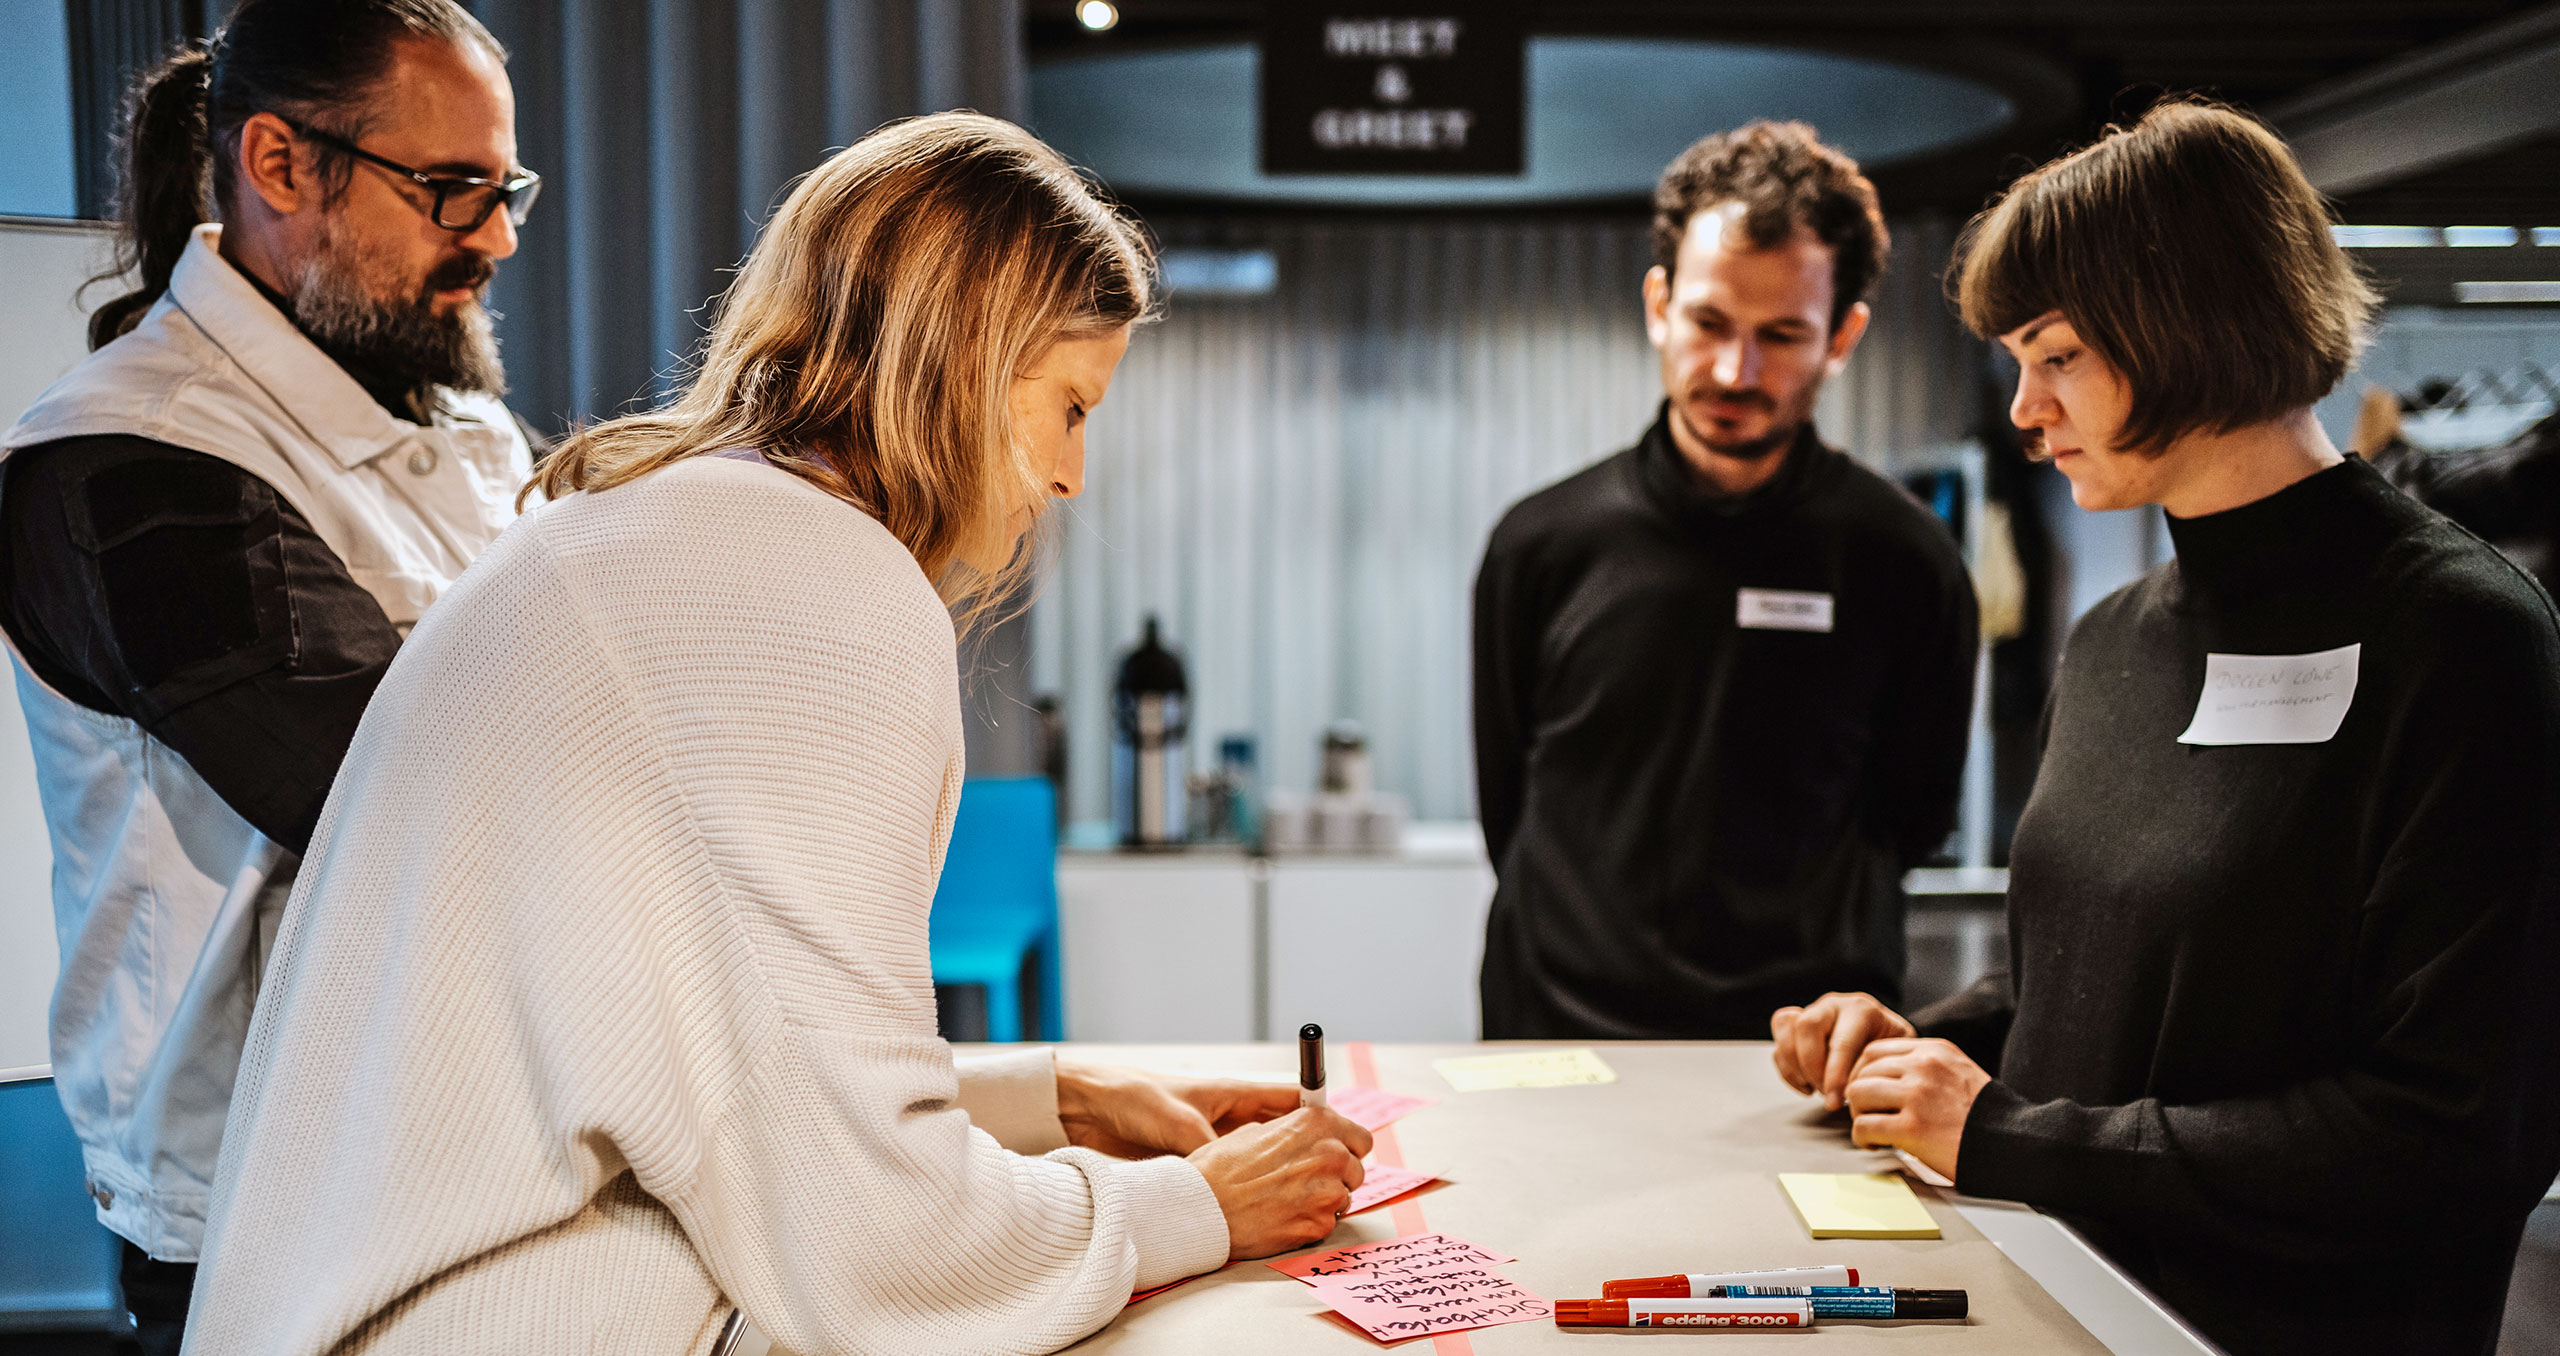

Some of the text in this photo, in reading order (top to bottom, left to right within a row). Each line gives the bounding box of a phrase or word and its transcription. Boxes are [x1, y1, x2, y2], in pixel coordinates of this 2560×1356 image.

[1326, 19, 1456, 56] MEET
[1312, 109, 1473, 149] GREET
[1662, 1314, 1788, 1327] edding 3000
